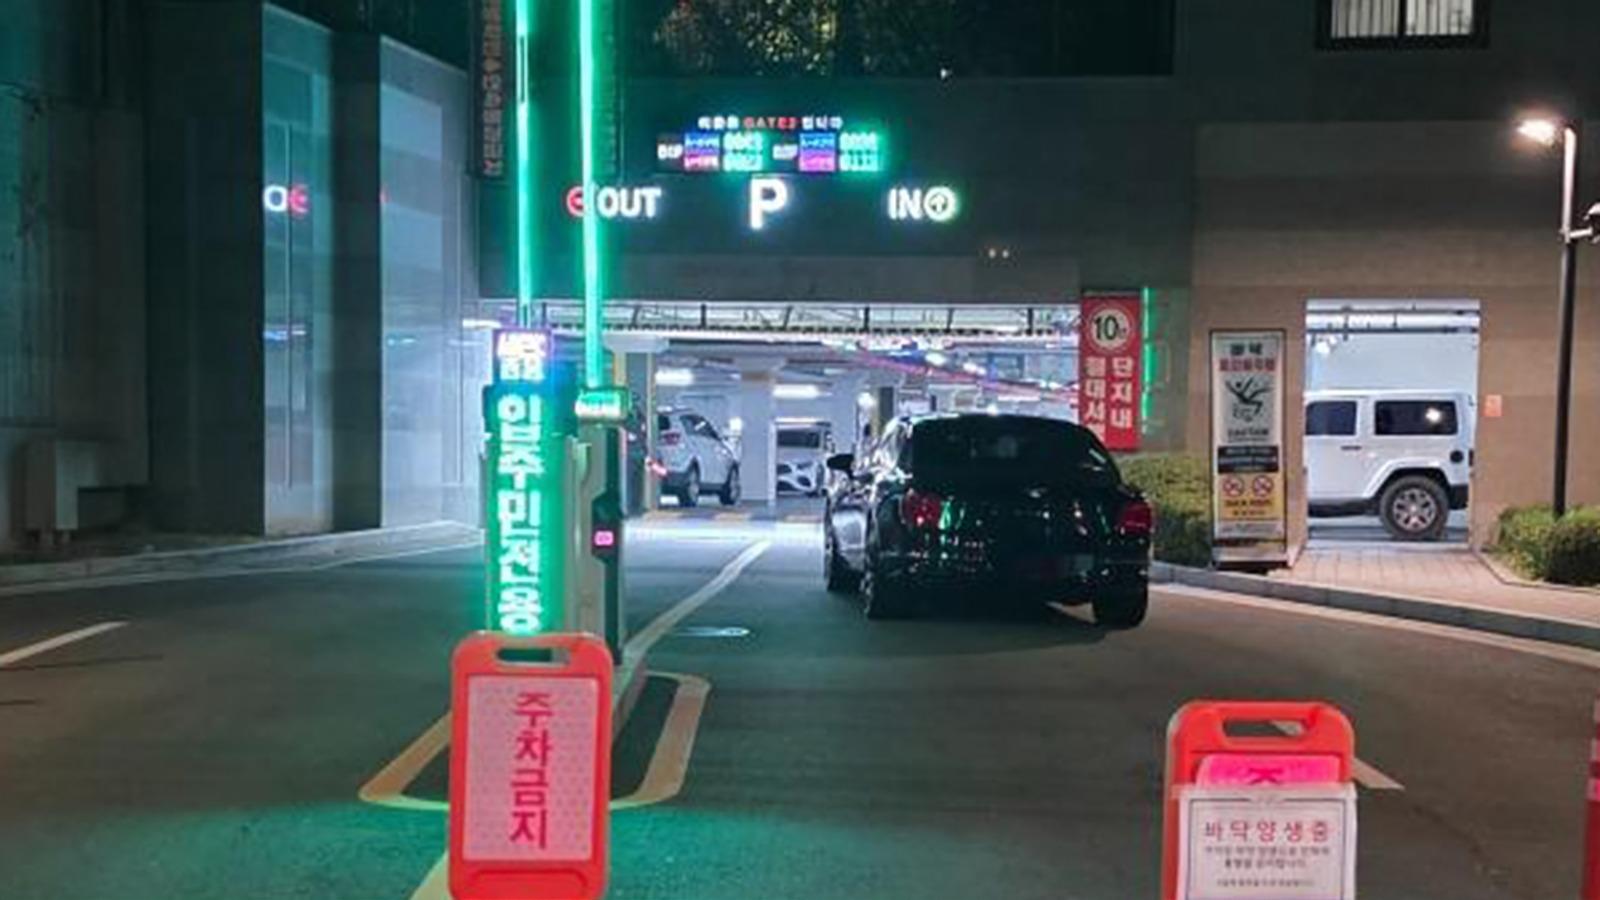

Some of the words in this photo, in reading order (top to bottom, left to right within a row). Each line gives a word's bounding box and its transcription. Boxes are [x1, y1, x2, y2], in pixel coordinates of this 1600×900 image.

[598, 186, 662, 218] OUT
[749, 178, 788, 230] P
[888, 187, 922, 220] IN
[1110, 356, 1134, 429] 단지내
[497, 394, 543, 635] 입주민전용
[509, 692, 554, 849] 주차금지
